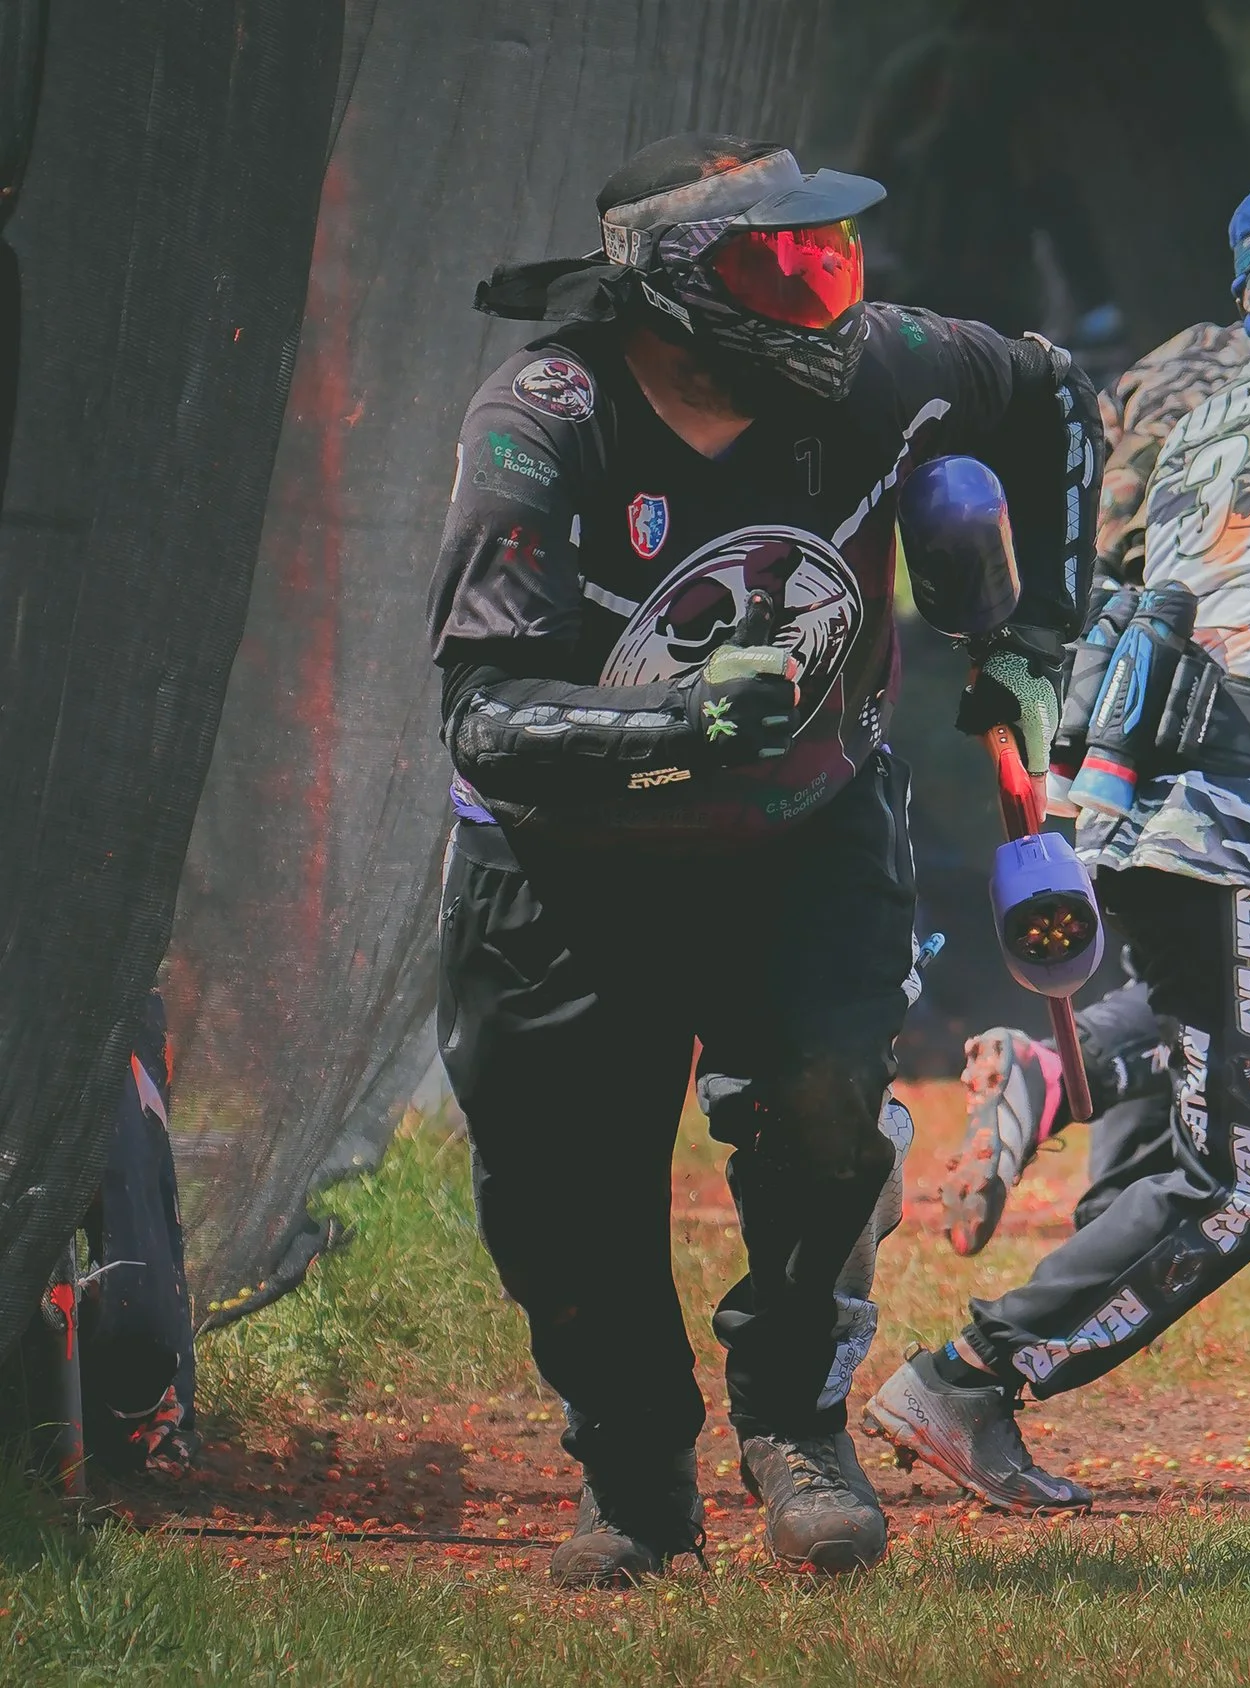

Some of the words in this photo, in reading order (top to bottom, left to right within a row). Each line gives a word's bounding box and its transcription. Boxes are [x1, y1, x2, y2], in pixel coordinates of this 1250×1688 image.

[494, 446, 514, 459] C.S.
[517, 453, 534, 466] On
[538, 461, 559, 478] Top
[503, 459, 551, 486] Roofing
[794, 437, 821, 496] 1
[1176, 435, 1249, 559] 3
[627, 769, 691, 789] EXALT
[766, 800, 791, 813] C.S.
[794, 789, 808, 802] On
[1012, 1288, 1149, 1383] REAPERS
[903, 1389, 929, 1427] vapor
